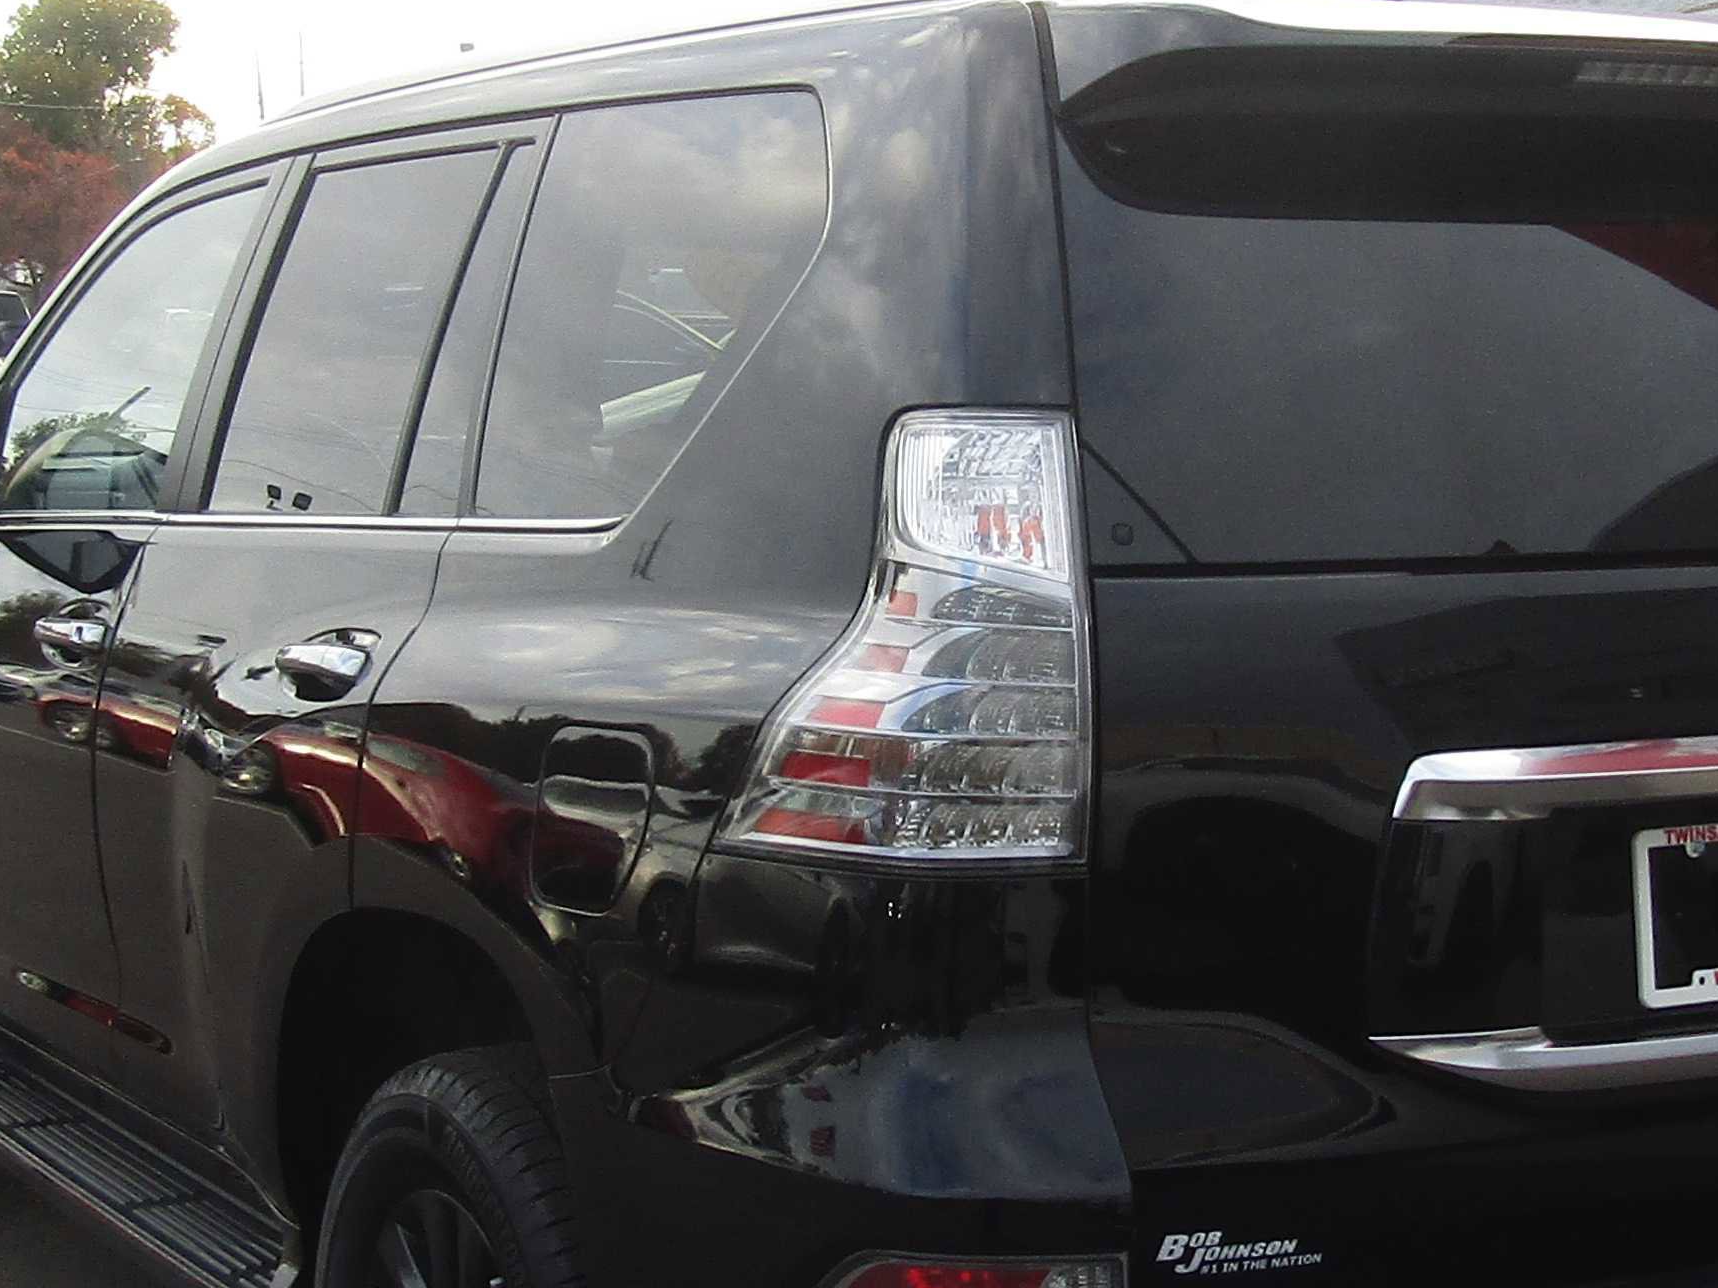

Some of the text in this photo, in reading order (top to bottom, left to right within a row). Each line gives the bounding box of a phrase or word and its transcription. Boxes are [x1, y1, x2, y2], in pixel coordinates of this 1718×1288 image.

[1155, 1231, 1223, 1262] BOB
[1174, 1238, 1299, 1274] JOHNSON
[1200, 1253, 1323, 1275] #1 IN THE NATION
